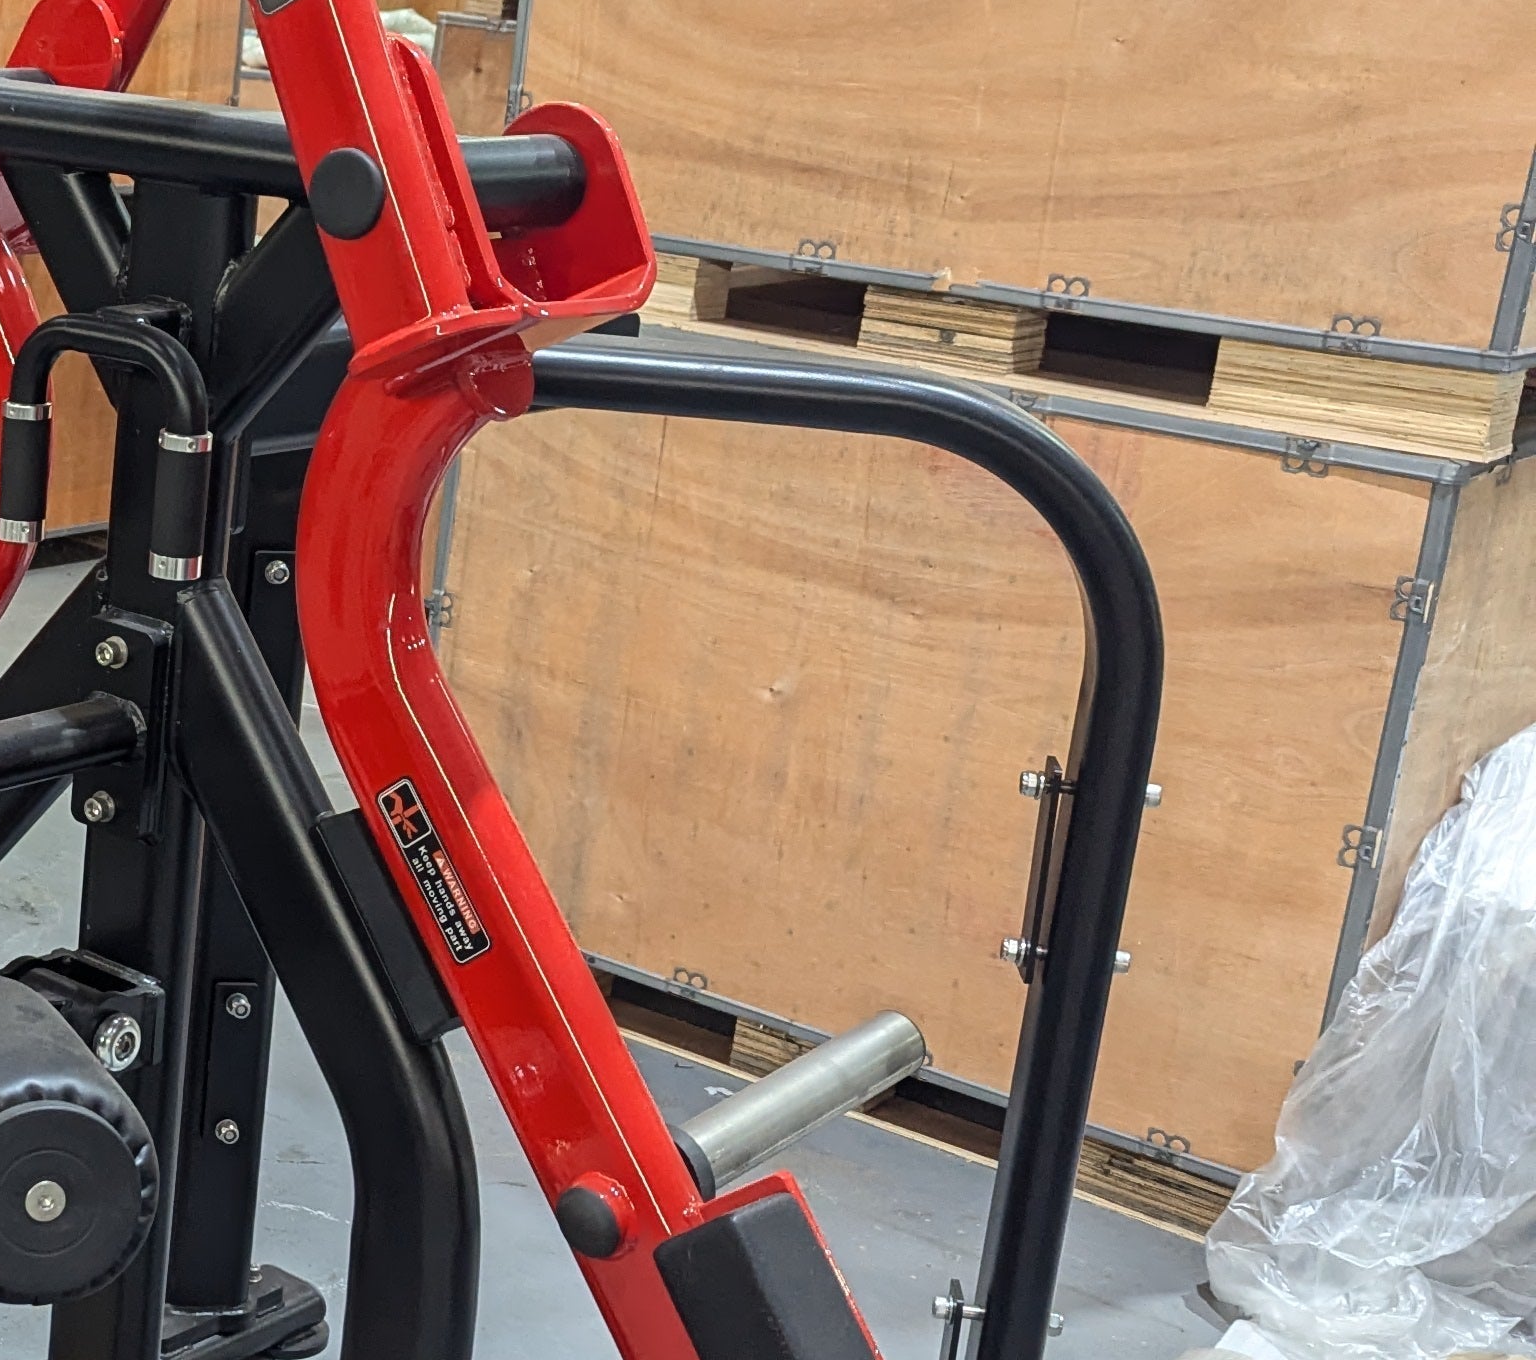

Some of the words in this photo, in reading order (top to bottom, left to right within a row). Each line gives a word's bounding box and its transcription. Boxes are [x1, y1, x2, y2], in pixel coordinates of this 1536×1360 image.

[411, 858, 424, 874] all
[422, 879, 447, 924] moving
[445, 927, 462, 952] part
[418, 846, 436, 877] Keep
[434, 880, 456, 917] hands
[455, 920, 474, 951] away
[442, 868, 478, 930] WARNING
